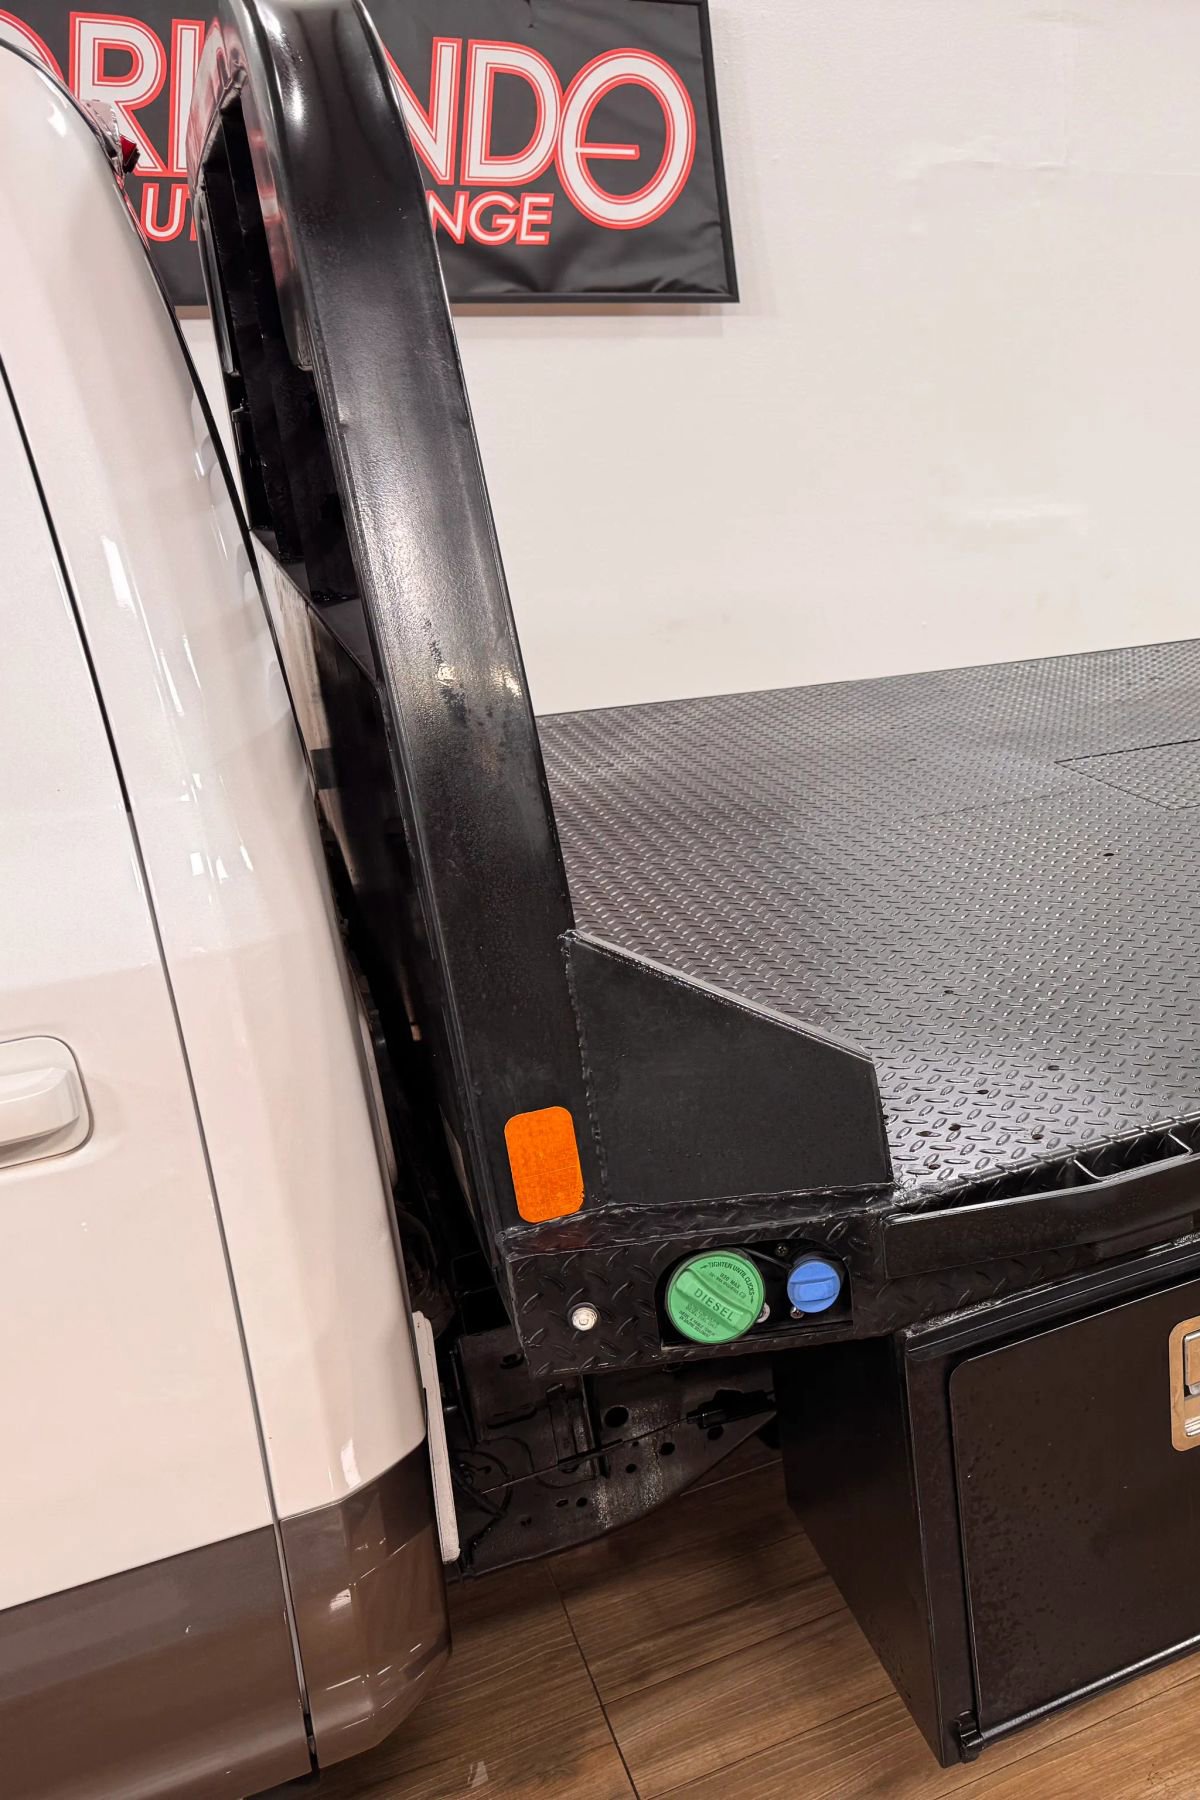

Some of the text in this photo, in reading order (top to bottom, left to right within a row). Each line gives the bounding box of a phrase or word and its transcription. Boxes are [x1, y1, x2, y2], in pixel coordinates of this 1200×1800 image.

[0, 9, 697, 230] RNDO
[424, 190, 554, 245] NGE
[707, 1261, 733, 1270] TIGHTEN
[732, 1265, 747, 1279] UNTIL
[744, 1276, 755, 1296] CLICKS
[694, 1287, 734, 1322] DIESEL
